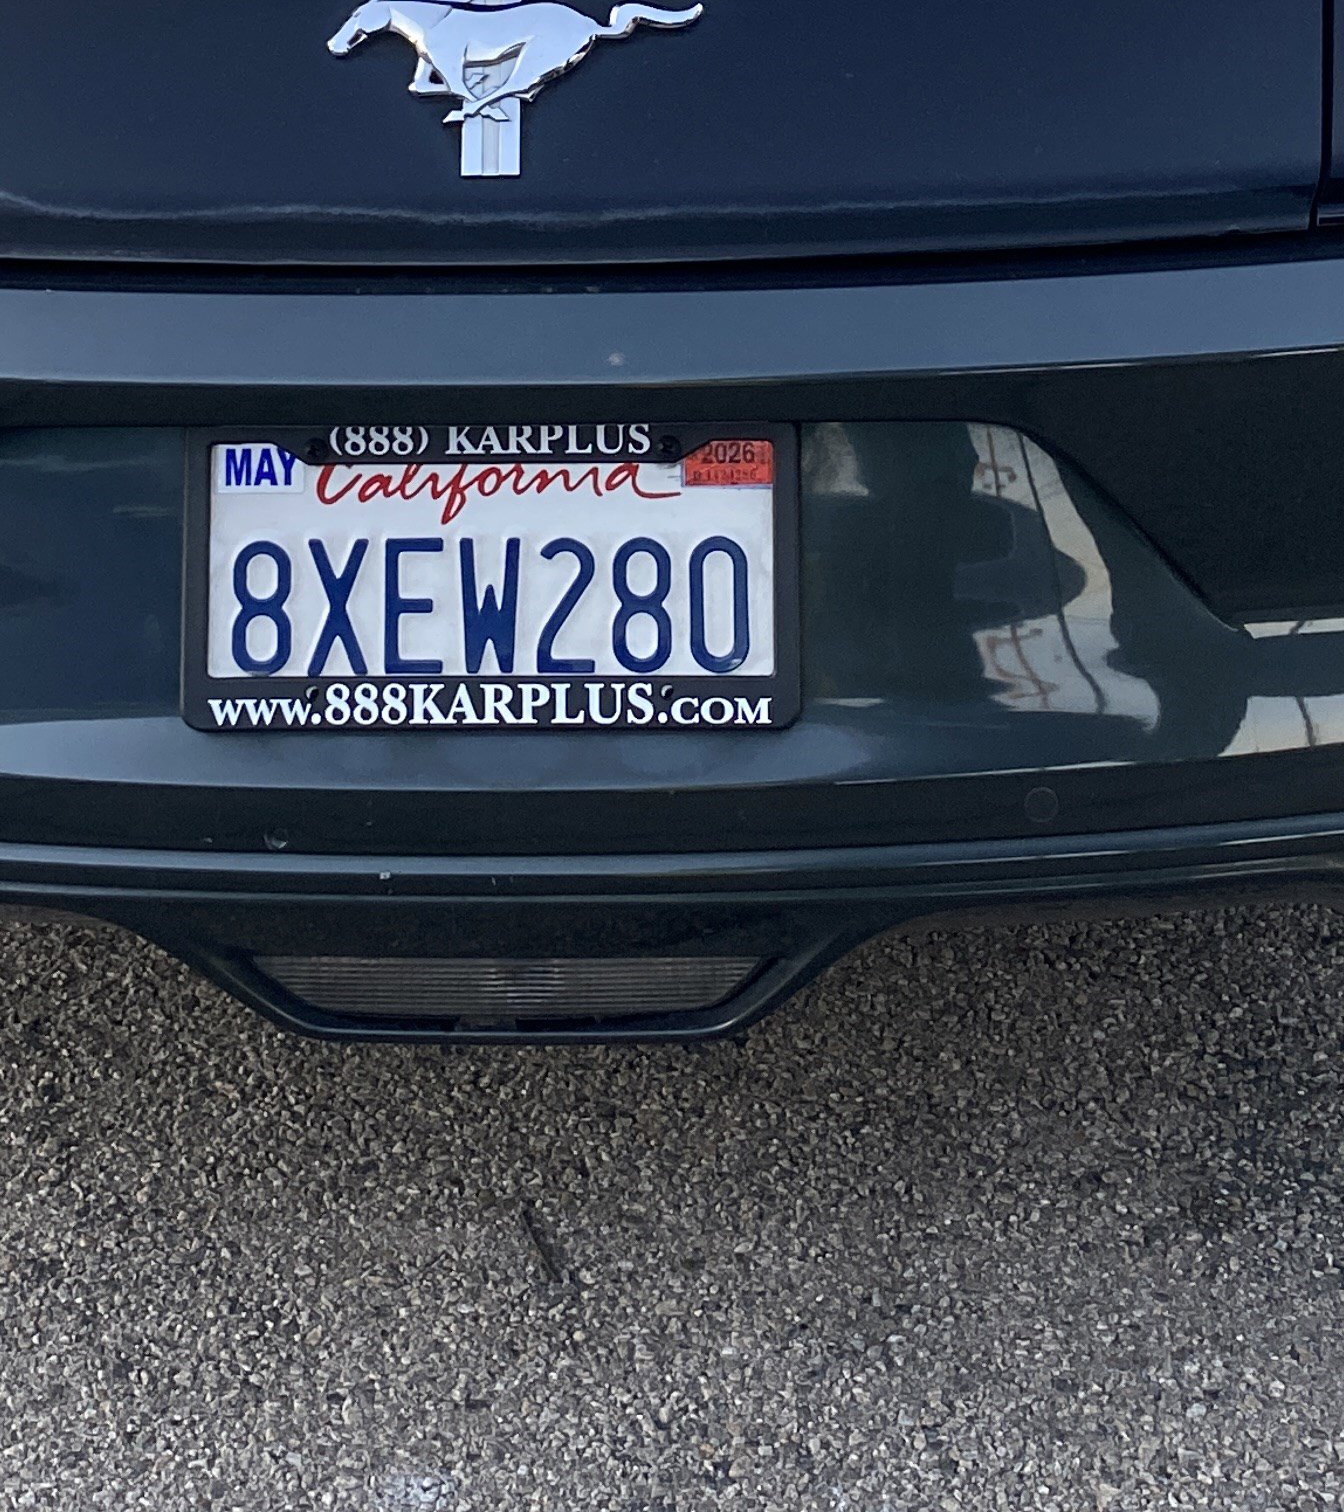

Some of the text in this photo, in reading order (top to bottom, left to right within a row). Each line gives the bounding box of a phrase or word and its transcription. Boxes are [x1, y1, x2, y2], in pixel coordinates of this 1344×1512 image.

[329, 423, 652, 456] (888) KARPLUS
[701, 442, 755, 464] 2026
[225, 448, 297, 487] MAY
[316, 463, 682, 525] California
[231, 535, 750, 676] 8XEW280
